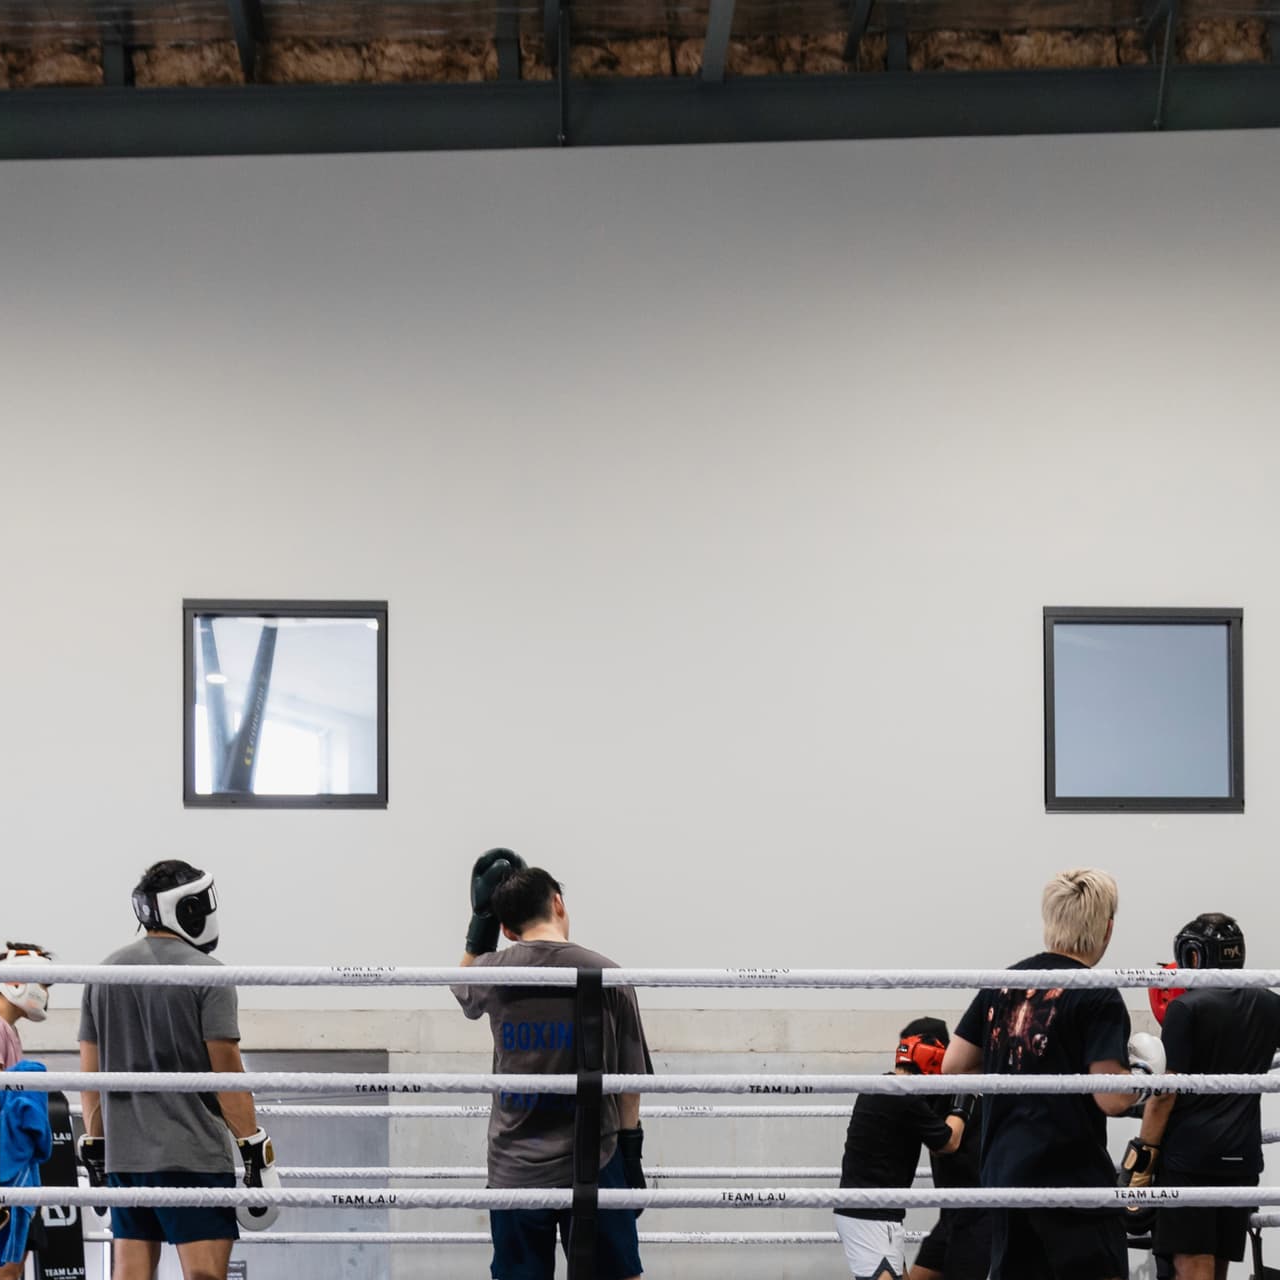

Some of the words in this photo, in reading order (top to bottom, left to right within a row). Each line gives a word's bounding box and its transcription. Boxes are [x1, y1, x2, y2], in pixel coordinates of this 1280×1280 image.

[502, 1022, 575, 1052] BOXIN
[355, 1084, 388, 1093] TEAM
[749, 1085, 782, 1094] TEAM
[784, 1085, 813, 1094] LAU
[722, 1192, 754, 1201] TEAM
[758, 1192, 786, 1201] L.A.U
[1115, 1190, 1146, 1199] TEAM
[1150, 1190, 1179, 1199] L.A.U
[332, 1195, 364, 1204] TEAM
[368, 1195, 397, 1204] L.A.U
